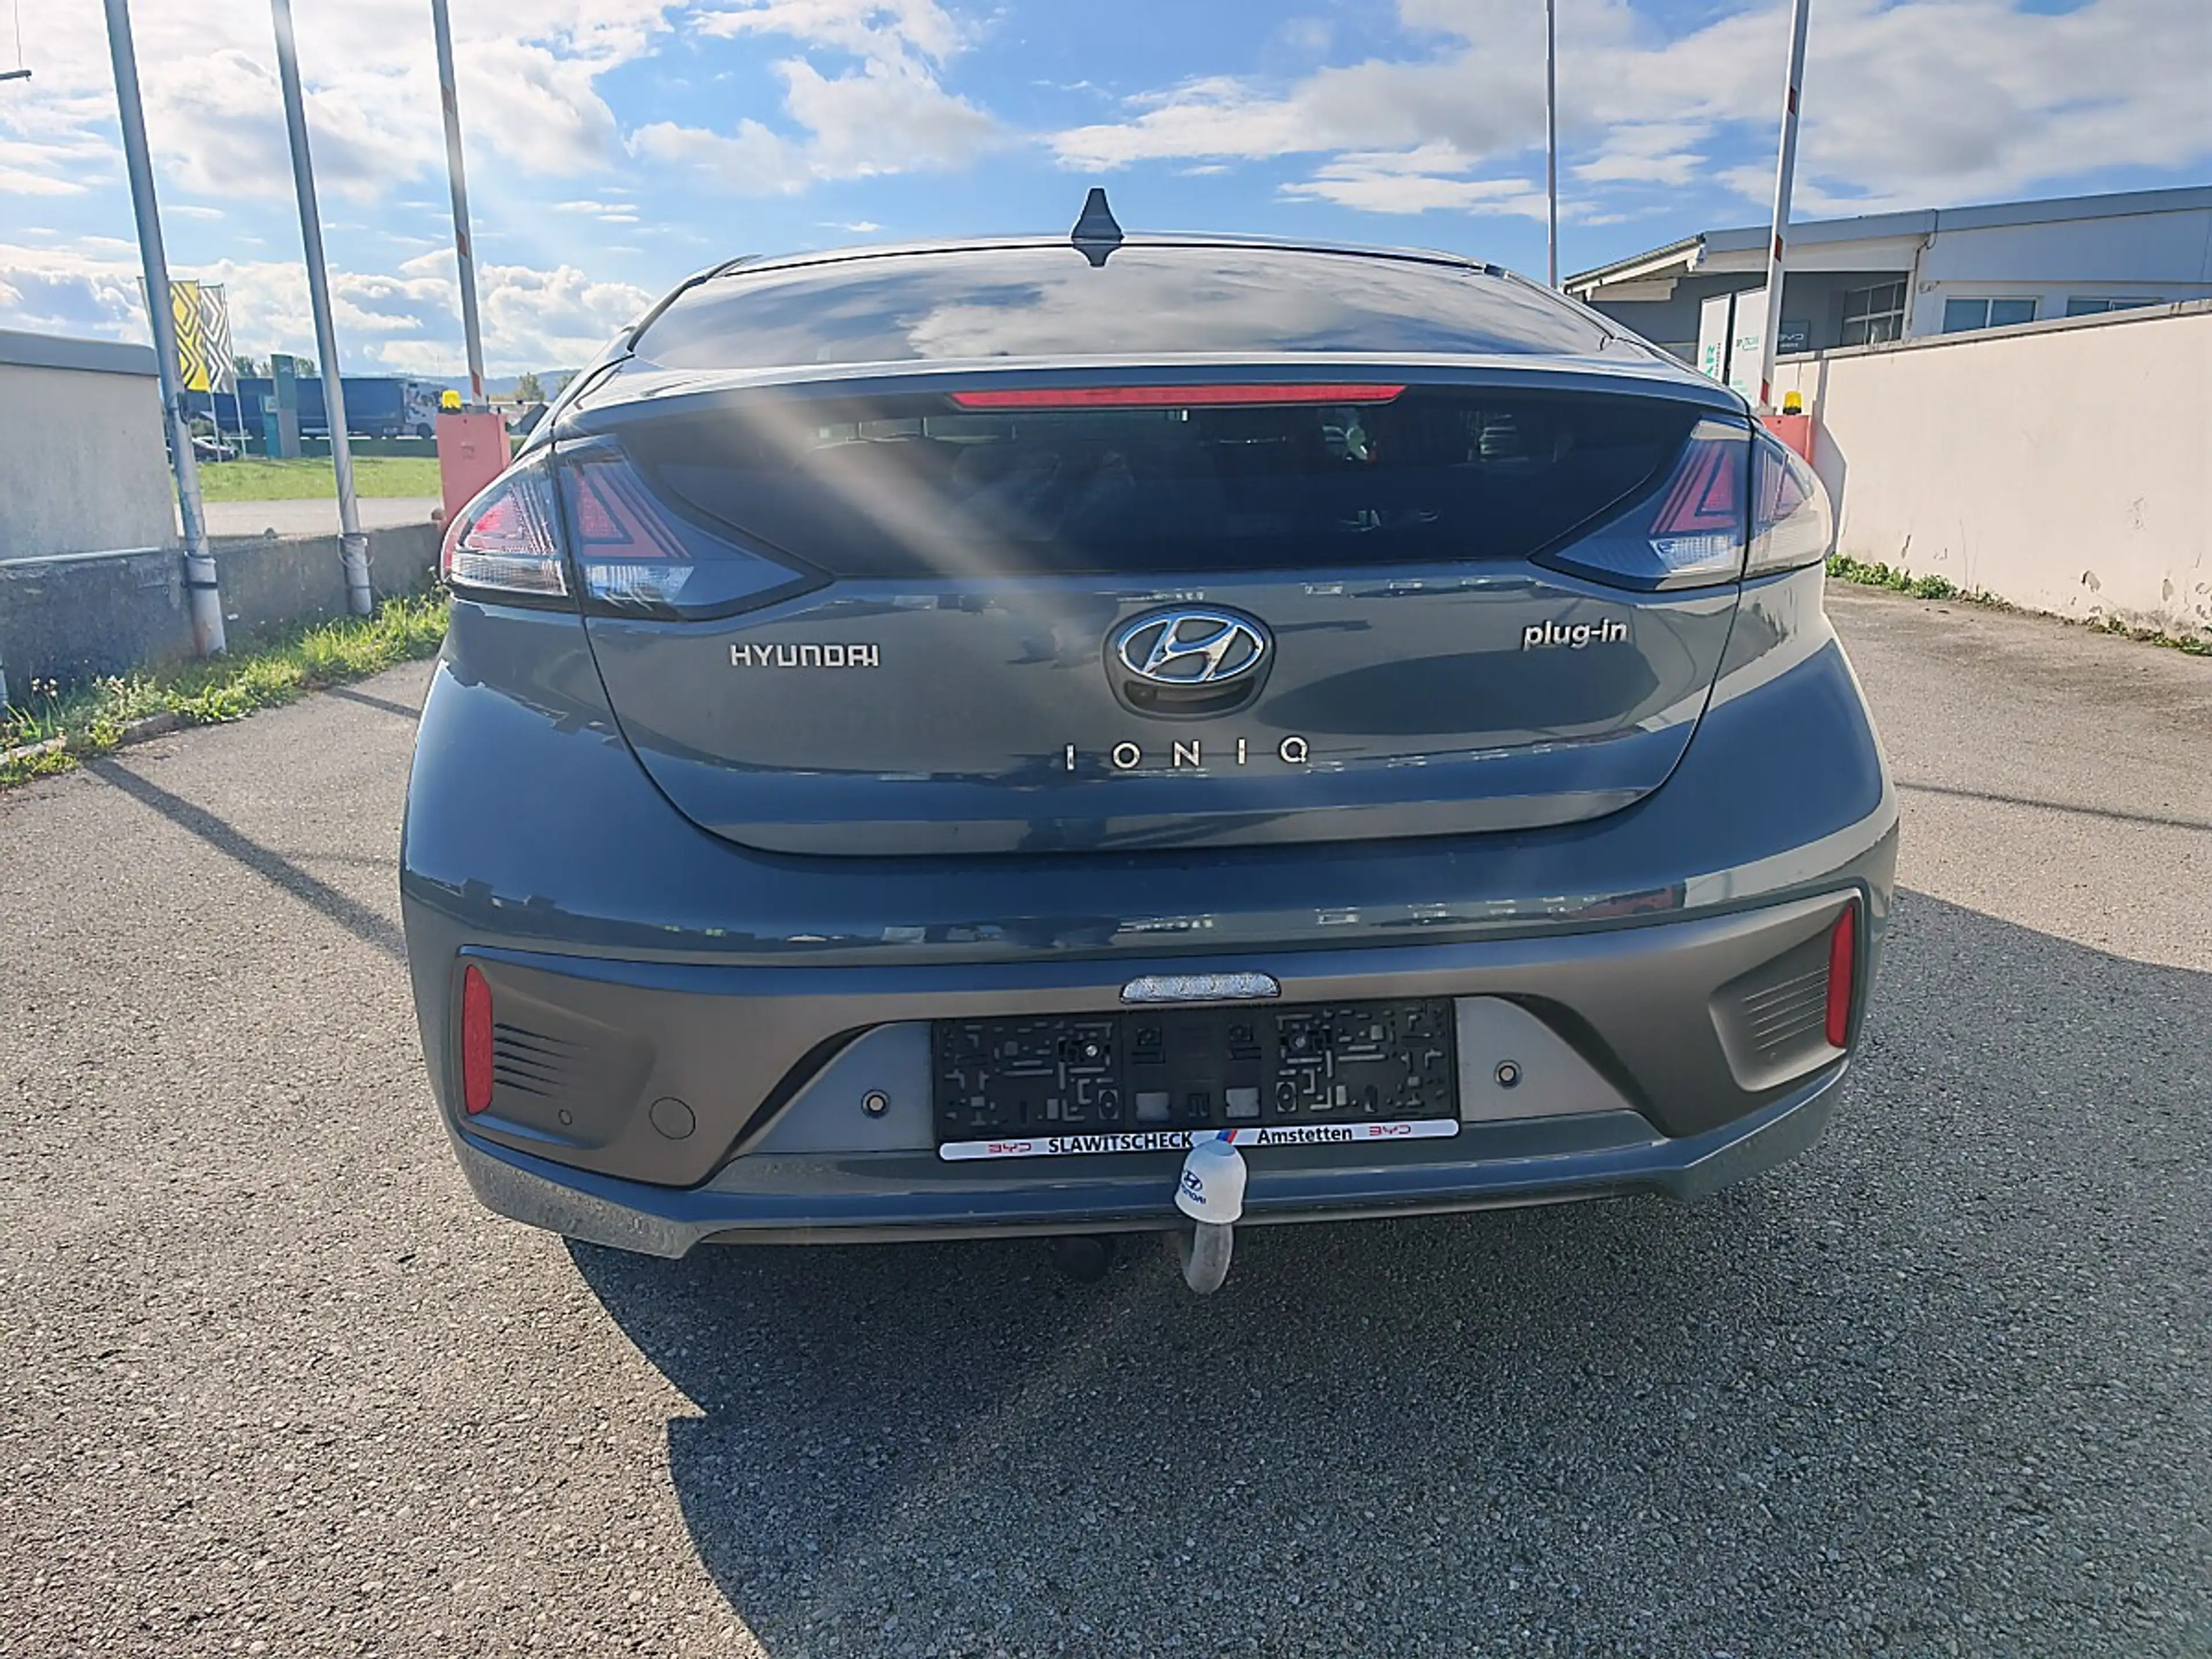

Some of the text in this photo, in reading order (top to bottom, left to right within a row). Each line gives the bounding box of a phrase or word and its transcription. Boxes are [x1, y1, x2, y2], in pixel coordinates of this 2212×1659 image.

[1523, 618, 1627, 652] plug-in
[729, 645, 879, 666] HYUNDAI
[1066, 736, 1308, 770] IONIQ
[1048, 1131, 1193, 1153] SLAWITSCHECK
[1256, 1127, 1353, 1144] Amstetten
